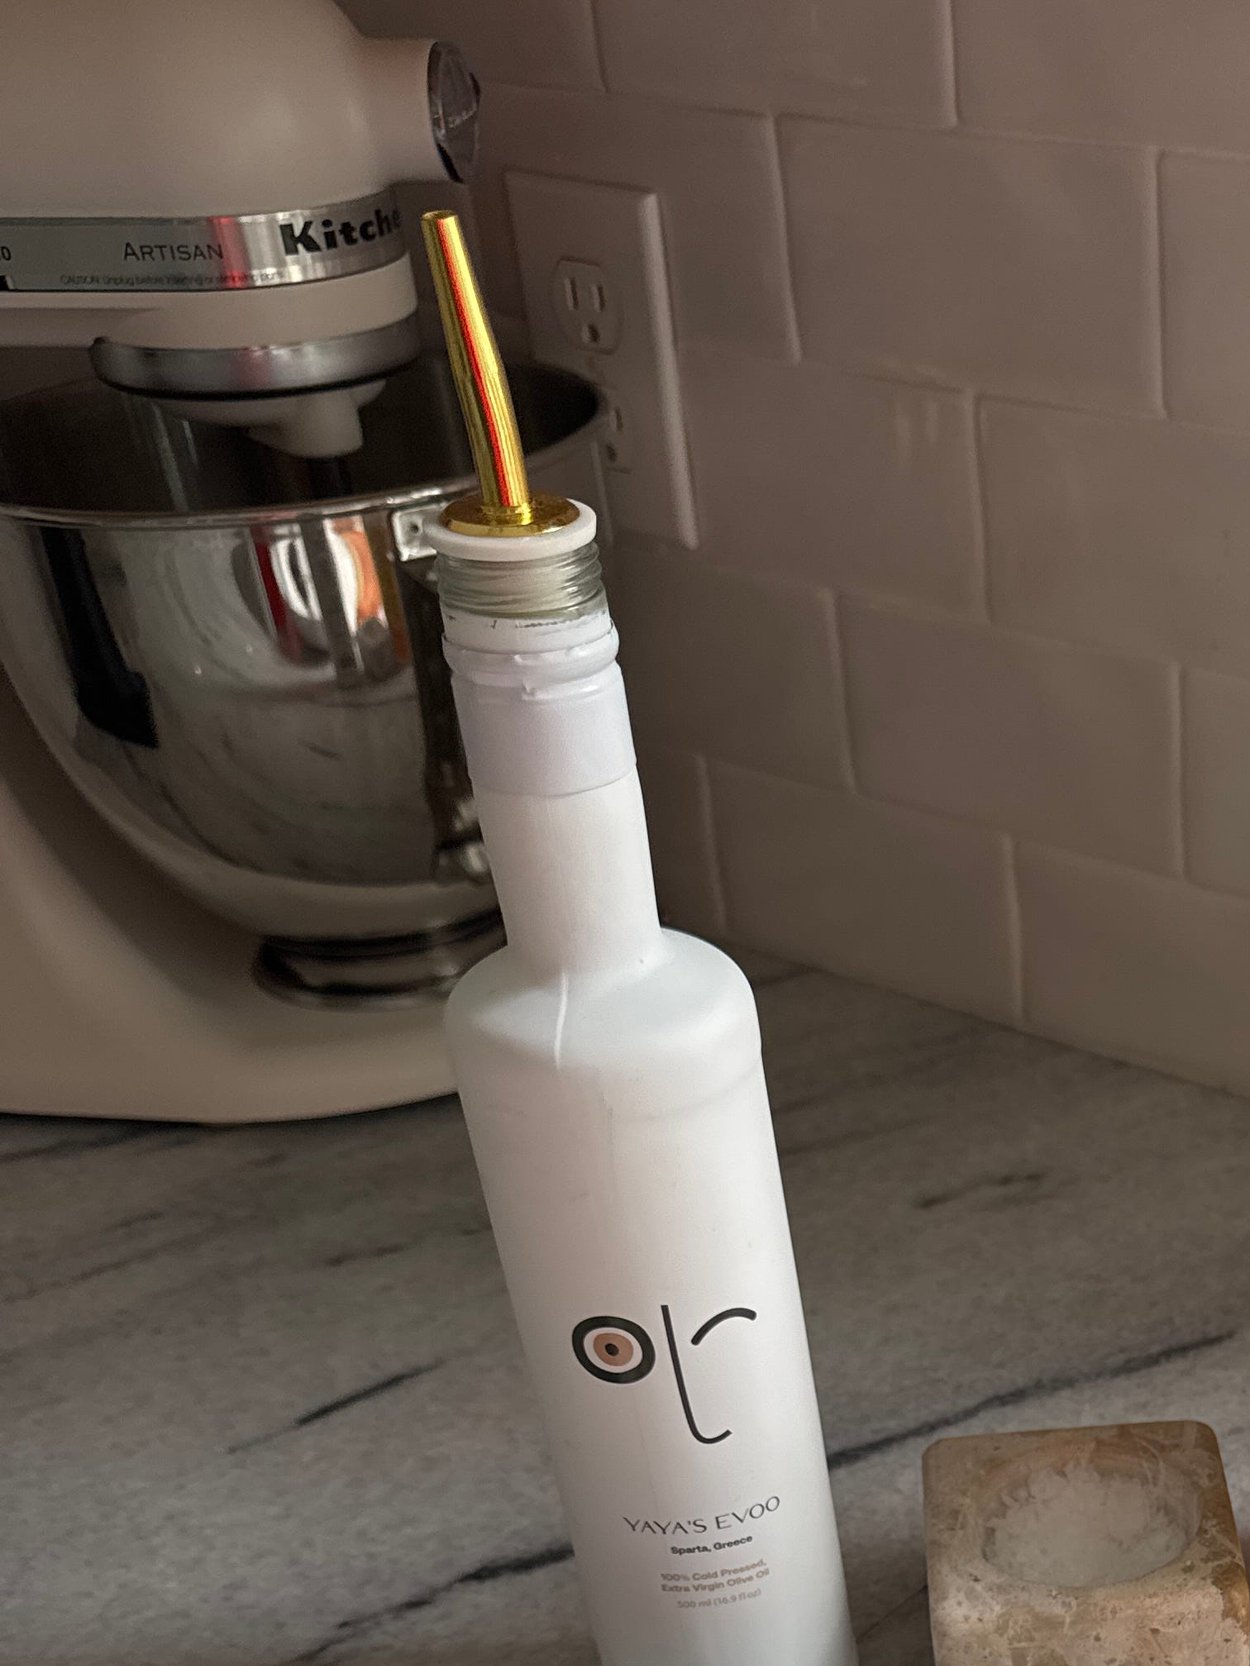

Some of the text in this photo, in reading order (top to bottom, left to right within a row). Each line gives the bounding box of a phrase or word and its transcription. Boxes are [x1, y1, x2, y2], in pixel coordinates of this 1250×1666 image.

[123, 241, 224, 262] ARTISAN
[622, 1495, 781, 1535] YAYA'S EVOO
[670, 1535, 753, 1556] Sparta, Greece
[661, 1568, 770, 1593] Extra Virgin Olive Oil
[692, 1571, 719, 1581] Cold
[720, 1559, 767, 1577] Pressed,
